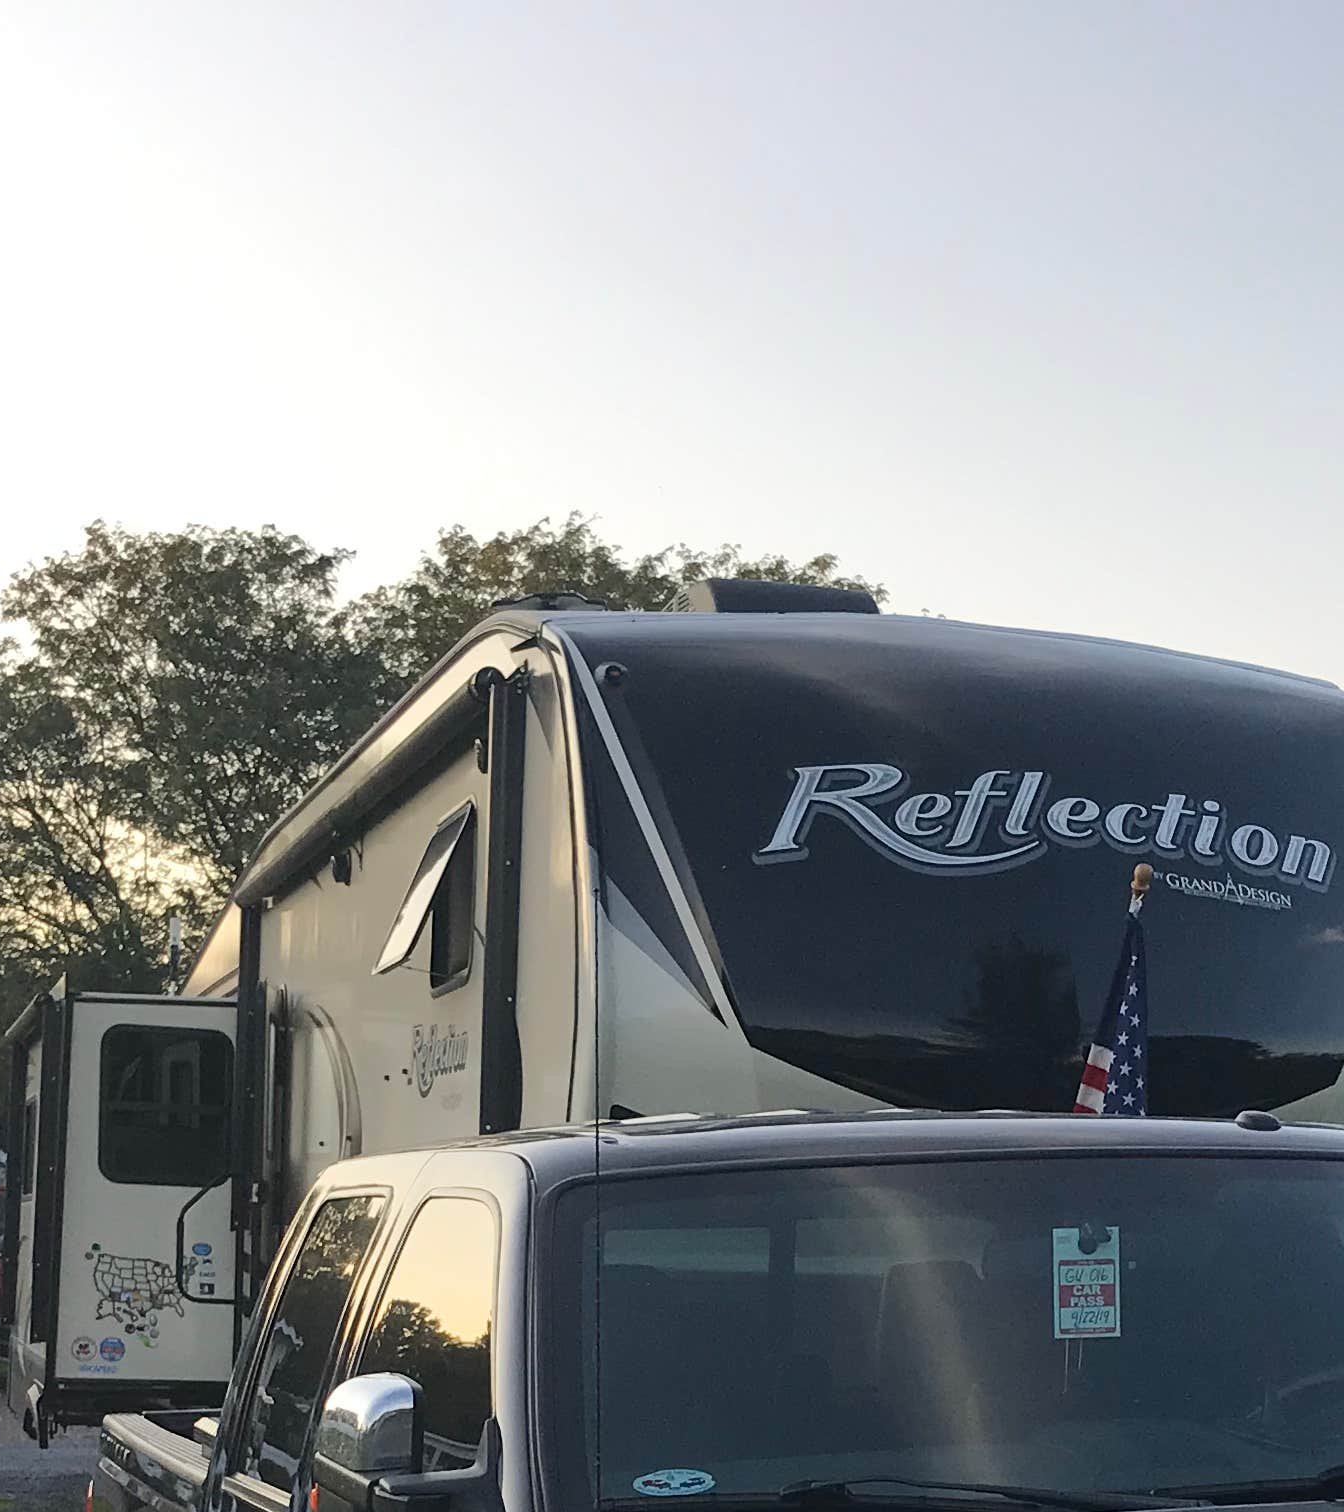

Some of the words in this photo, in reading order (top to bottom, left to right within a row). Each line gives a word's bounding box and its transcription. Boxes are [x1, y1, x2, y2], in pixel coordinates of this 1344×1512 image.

[753, 762, 1337, 892] Reflection
[1072, 1285, 1102, 1296] CAR
[1070, 1296, 1105, 1307] PASS
